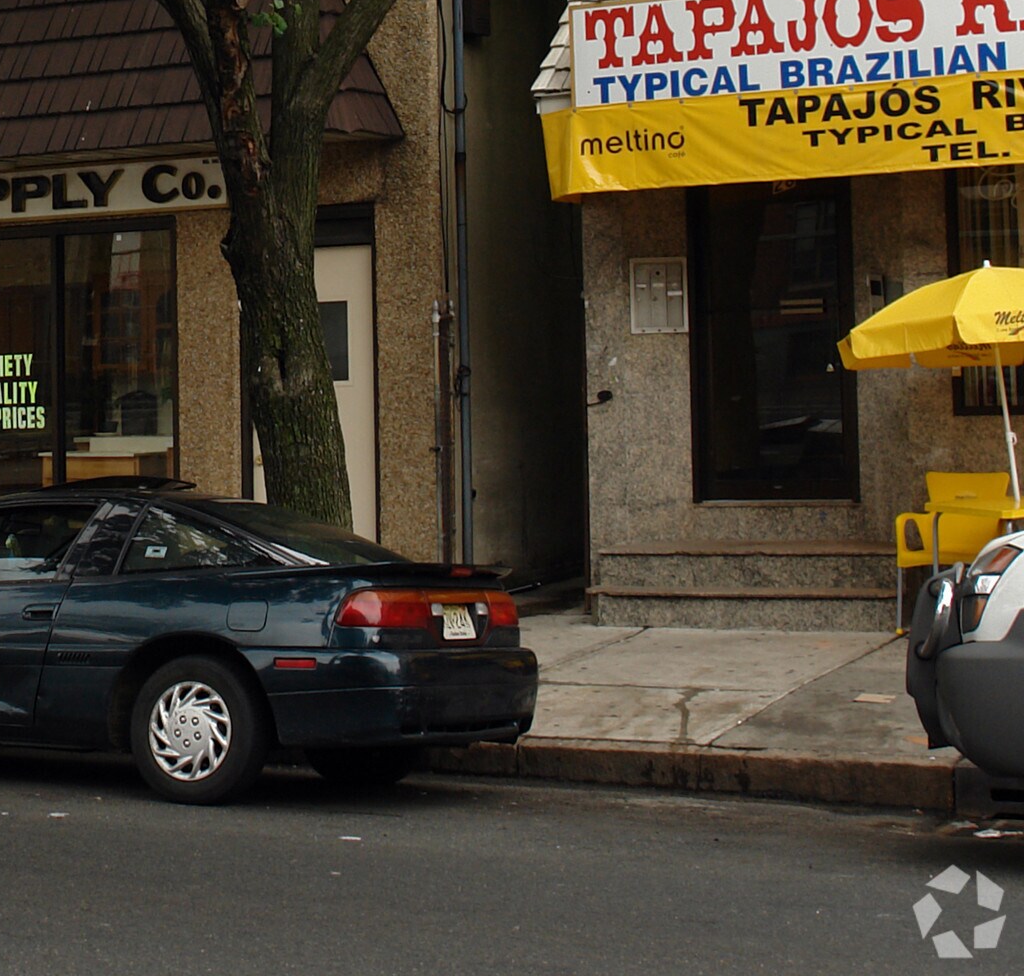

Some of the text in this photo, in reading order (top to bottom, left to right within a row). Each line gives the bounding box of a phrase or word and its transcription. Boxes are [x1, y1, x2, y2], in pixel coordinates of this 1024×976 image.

[593, 40, 1007, 104] TYPICAL BRAZILIAN
[738, 82, 941, 127] TAPAJÓS
[580, 128, 685, 156] meltino
[802, 118, 978, 147] TYPICAL
[921, 141, 1011, 162] TEL.
